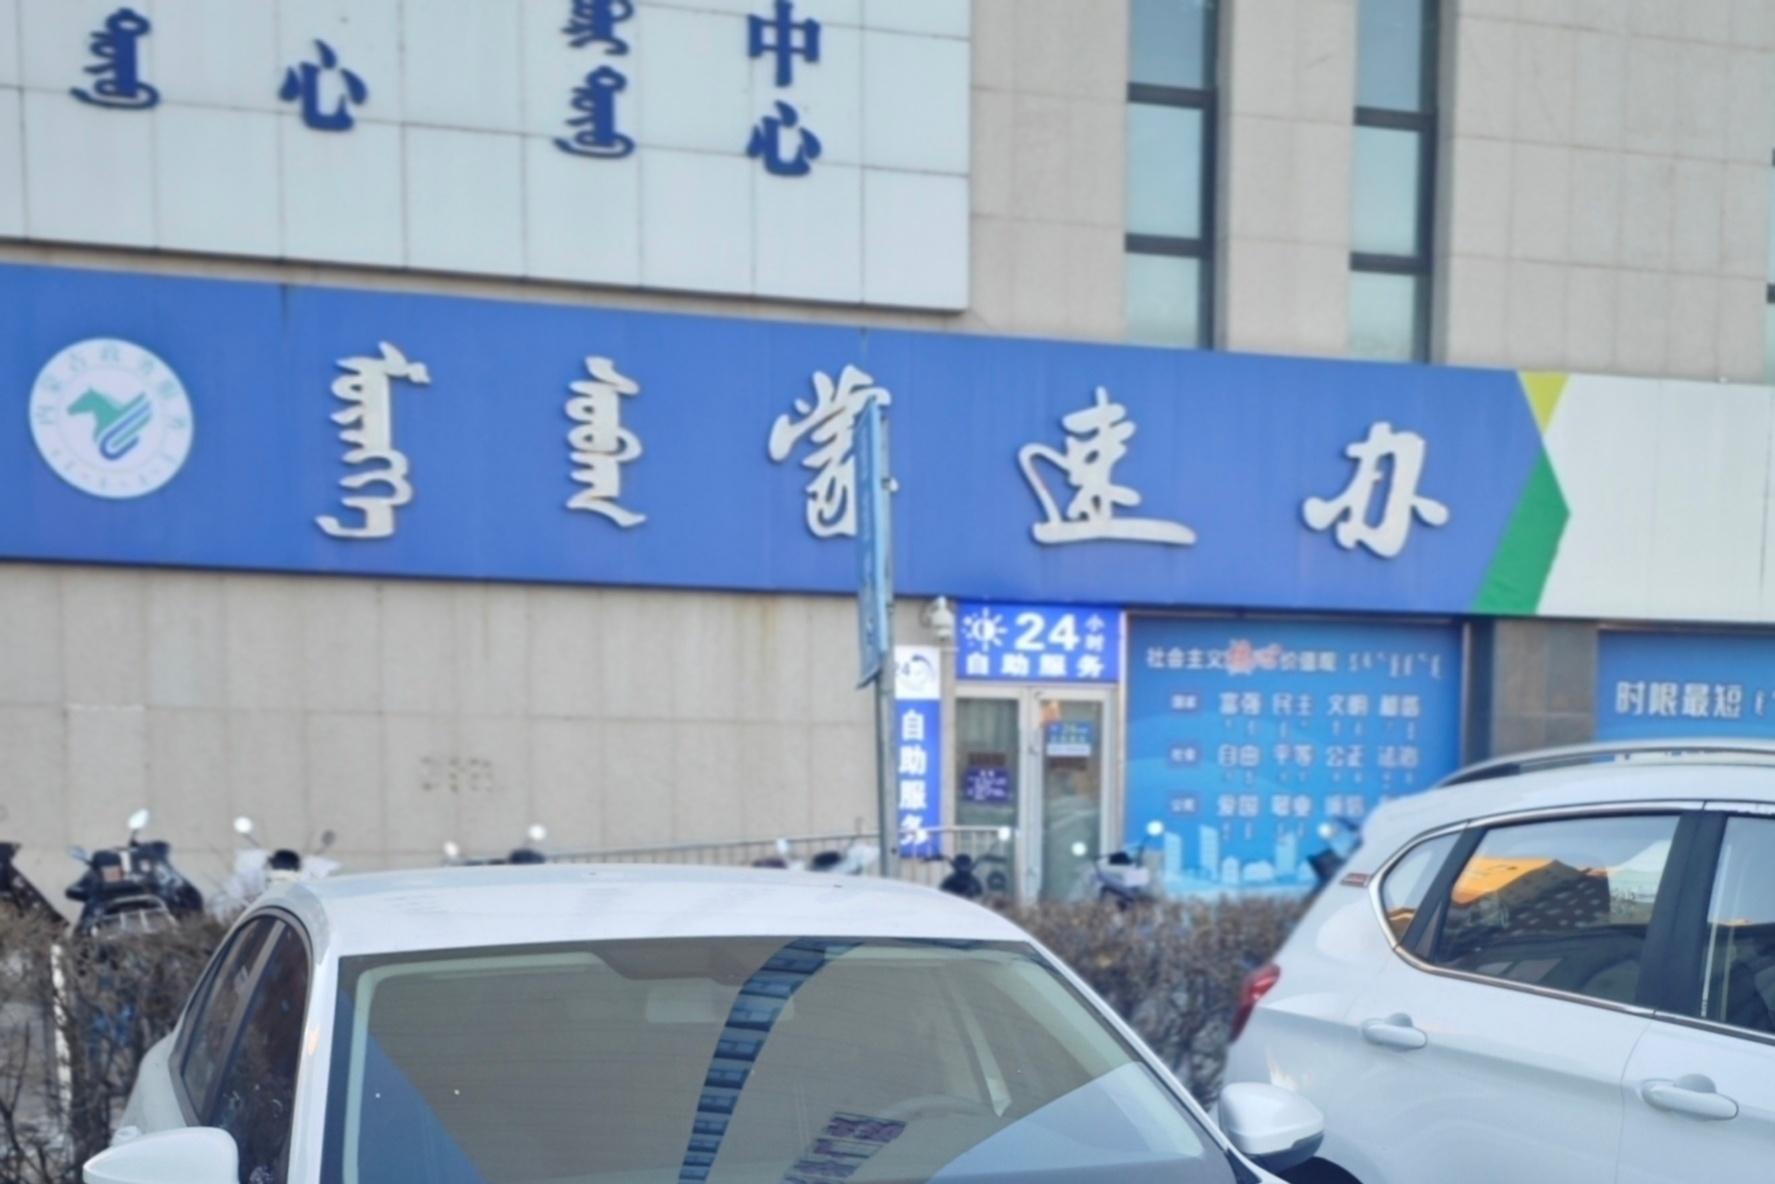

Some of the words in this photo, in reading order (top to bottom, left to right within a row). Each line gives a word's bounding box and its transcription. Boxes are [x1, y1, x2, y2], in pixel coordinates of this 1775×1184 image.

[278, 38, 368, 132] 心
[965, 653, 1105, 678] 自助服务
[1614, 680, 1743, 719] 时限最短
[898, 708, 929, 846] 自助服务
